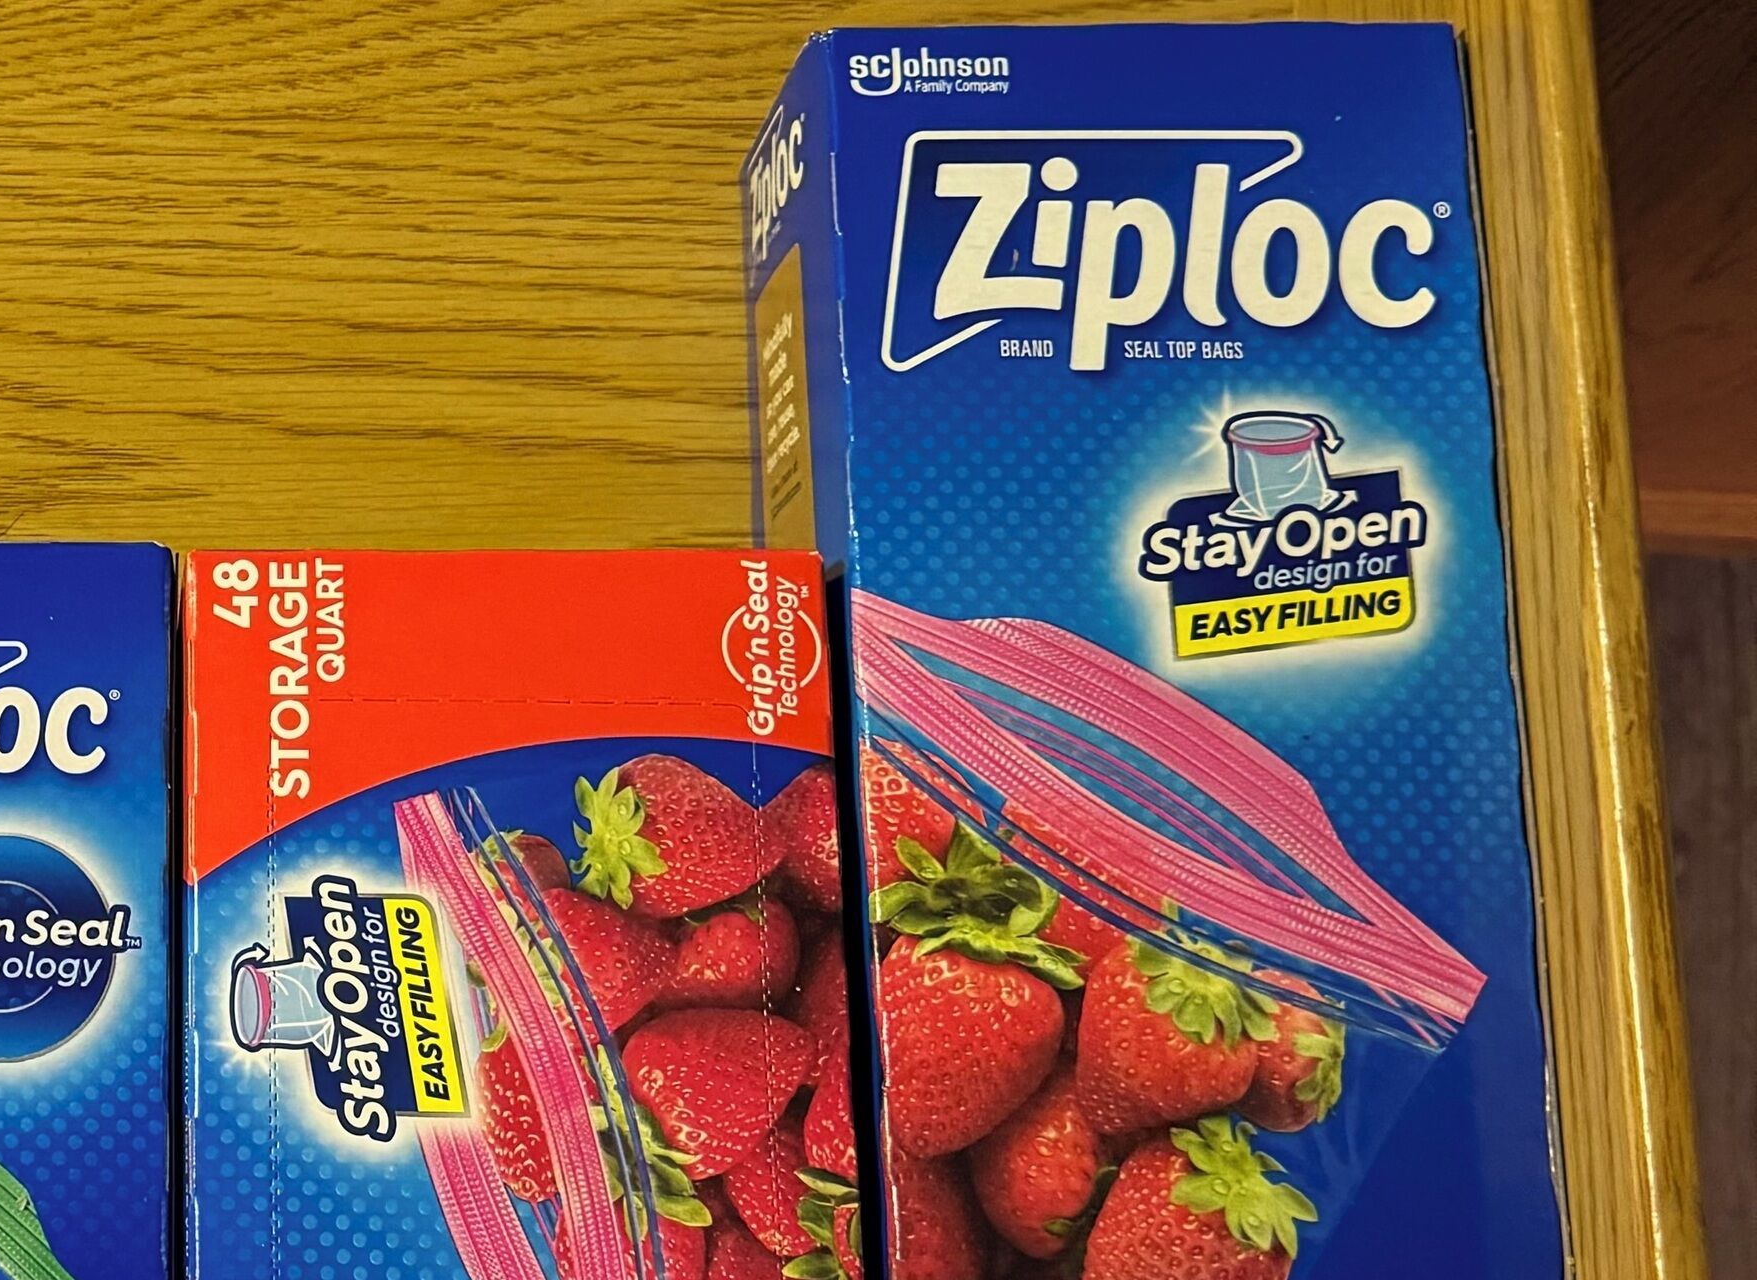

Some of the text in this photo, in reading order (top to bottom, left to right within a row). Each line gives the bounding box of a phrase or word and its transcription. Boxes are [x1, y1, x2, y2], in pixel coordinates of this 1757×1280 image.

[915, 80, 1009, 95] Family Company
[1000, 339, 1244, 359] BRAND SEAL TOP BAGS
[212, 559, 259, 629] 48
[740, 559, 770, 634] Seal
[1254, 552, 1398, 590] design for
[315, 557, 346, 683] QUART
[773, 576, 799, 717] Technology
[1190, 590, 1401, 641] EASY FILLING
[268, 560, 311, 800] STORAGE
[361, 906, 400, 1039] design for
[395, 906, 451, 1101] EASY FILLING
